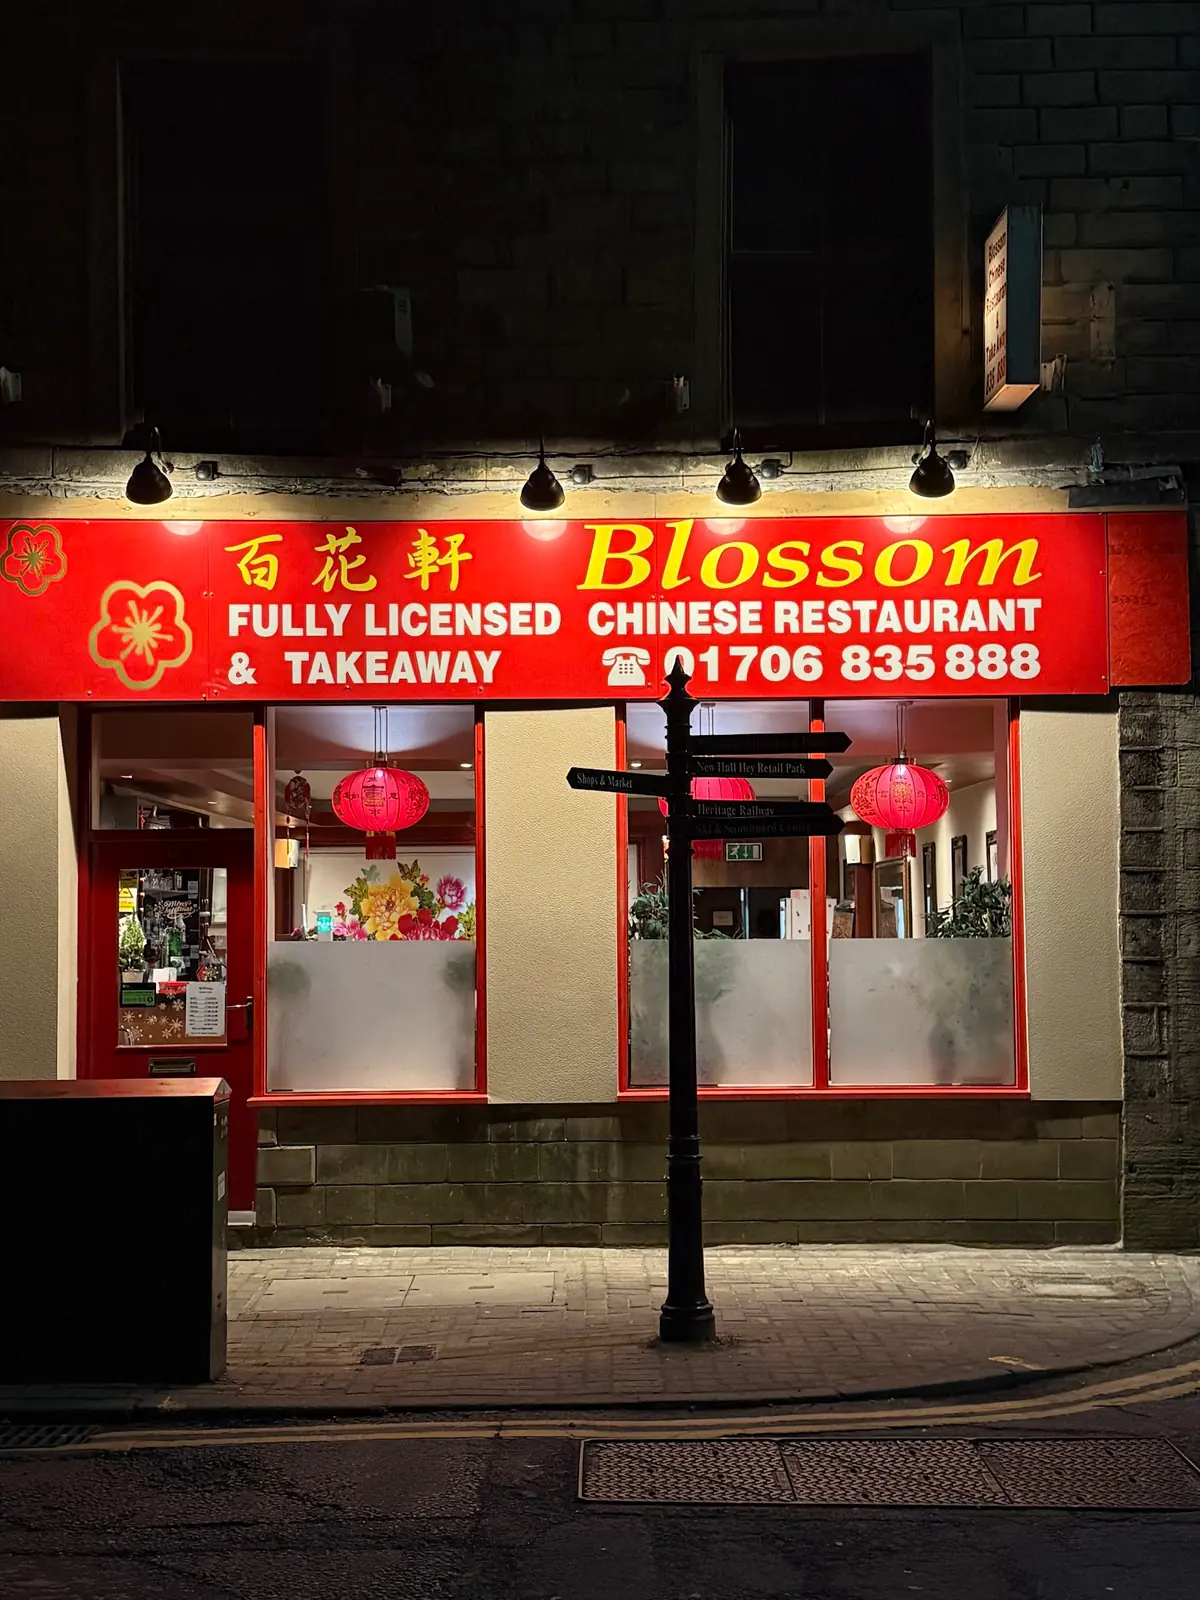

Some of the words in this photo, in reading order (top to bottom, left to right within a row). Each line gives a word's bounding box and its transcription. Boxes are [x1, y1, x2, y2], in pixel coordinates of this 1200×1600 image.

[224, 527, 473, 593] 百花軒
[576, 519, 1043, 590] Blossom
[228, 603, 352, 637] FULLY
[364, 602, 562, 636] LICENSED
[588, 601, 763, 636] CHINESE
[775, 599, 1042, 634] RESTAURANT
[228, 652, 257, 685] &
[284, 651, 501, 684] TAKEAWAY
[664, 645, 823, 682] 01706
[840, 644, 936, 681] 835
[946, 643, 1041, 680] 888
[577, 773, 598, 788] Shops
[600, 774, 606, 786] &
[608, 775, 633, 789] Market
[697, 761, 714, 773] New
[716, 761, 736, 773] Hall
[740, 762, 755, 775] Hey
[757, 761, 783, 774] Retail
[786, 763, 806, 774] Park
[698, 804, 737, 817] Heritage
[740, 805, 775, 816] Railway
